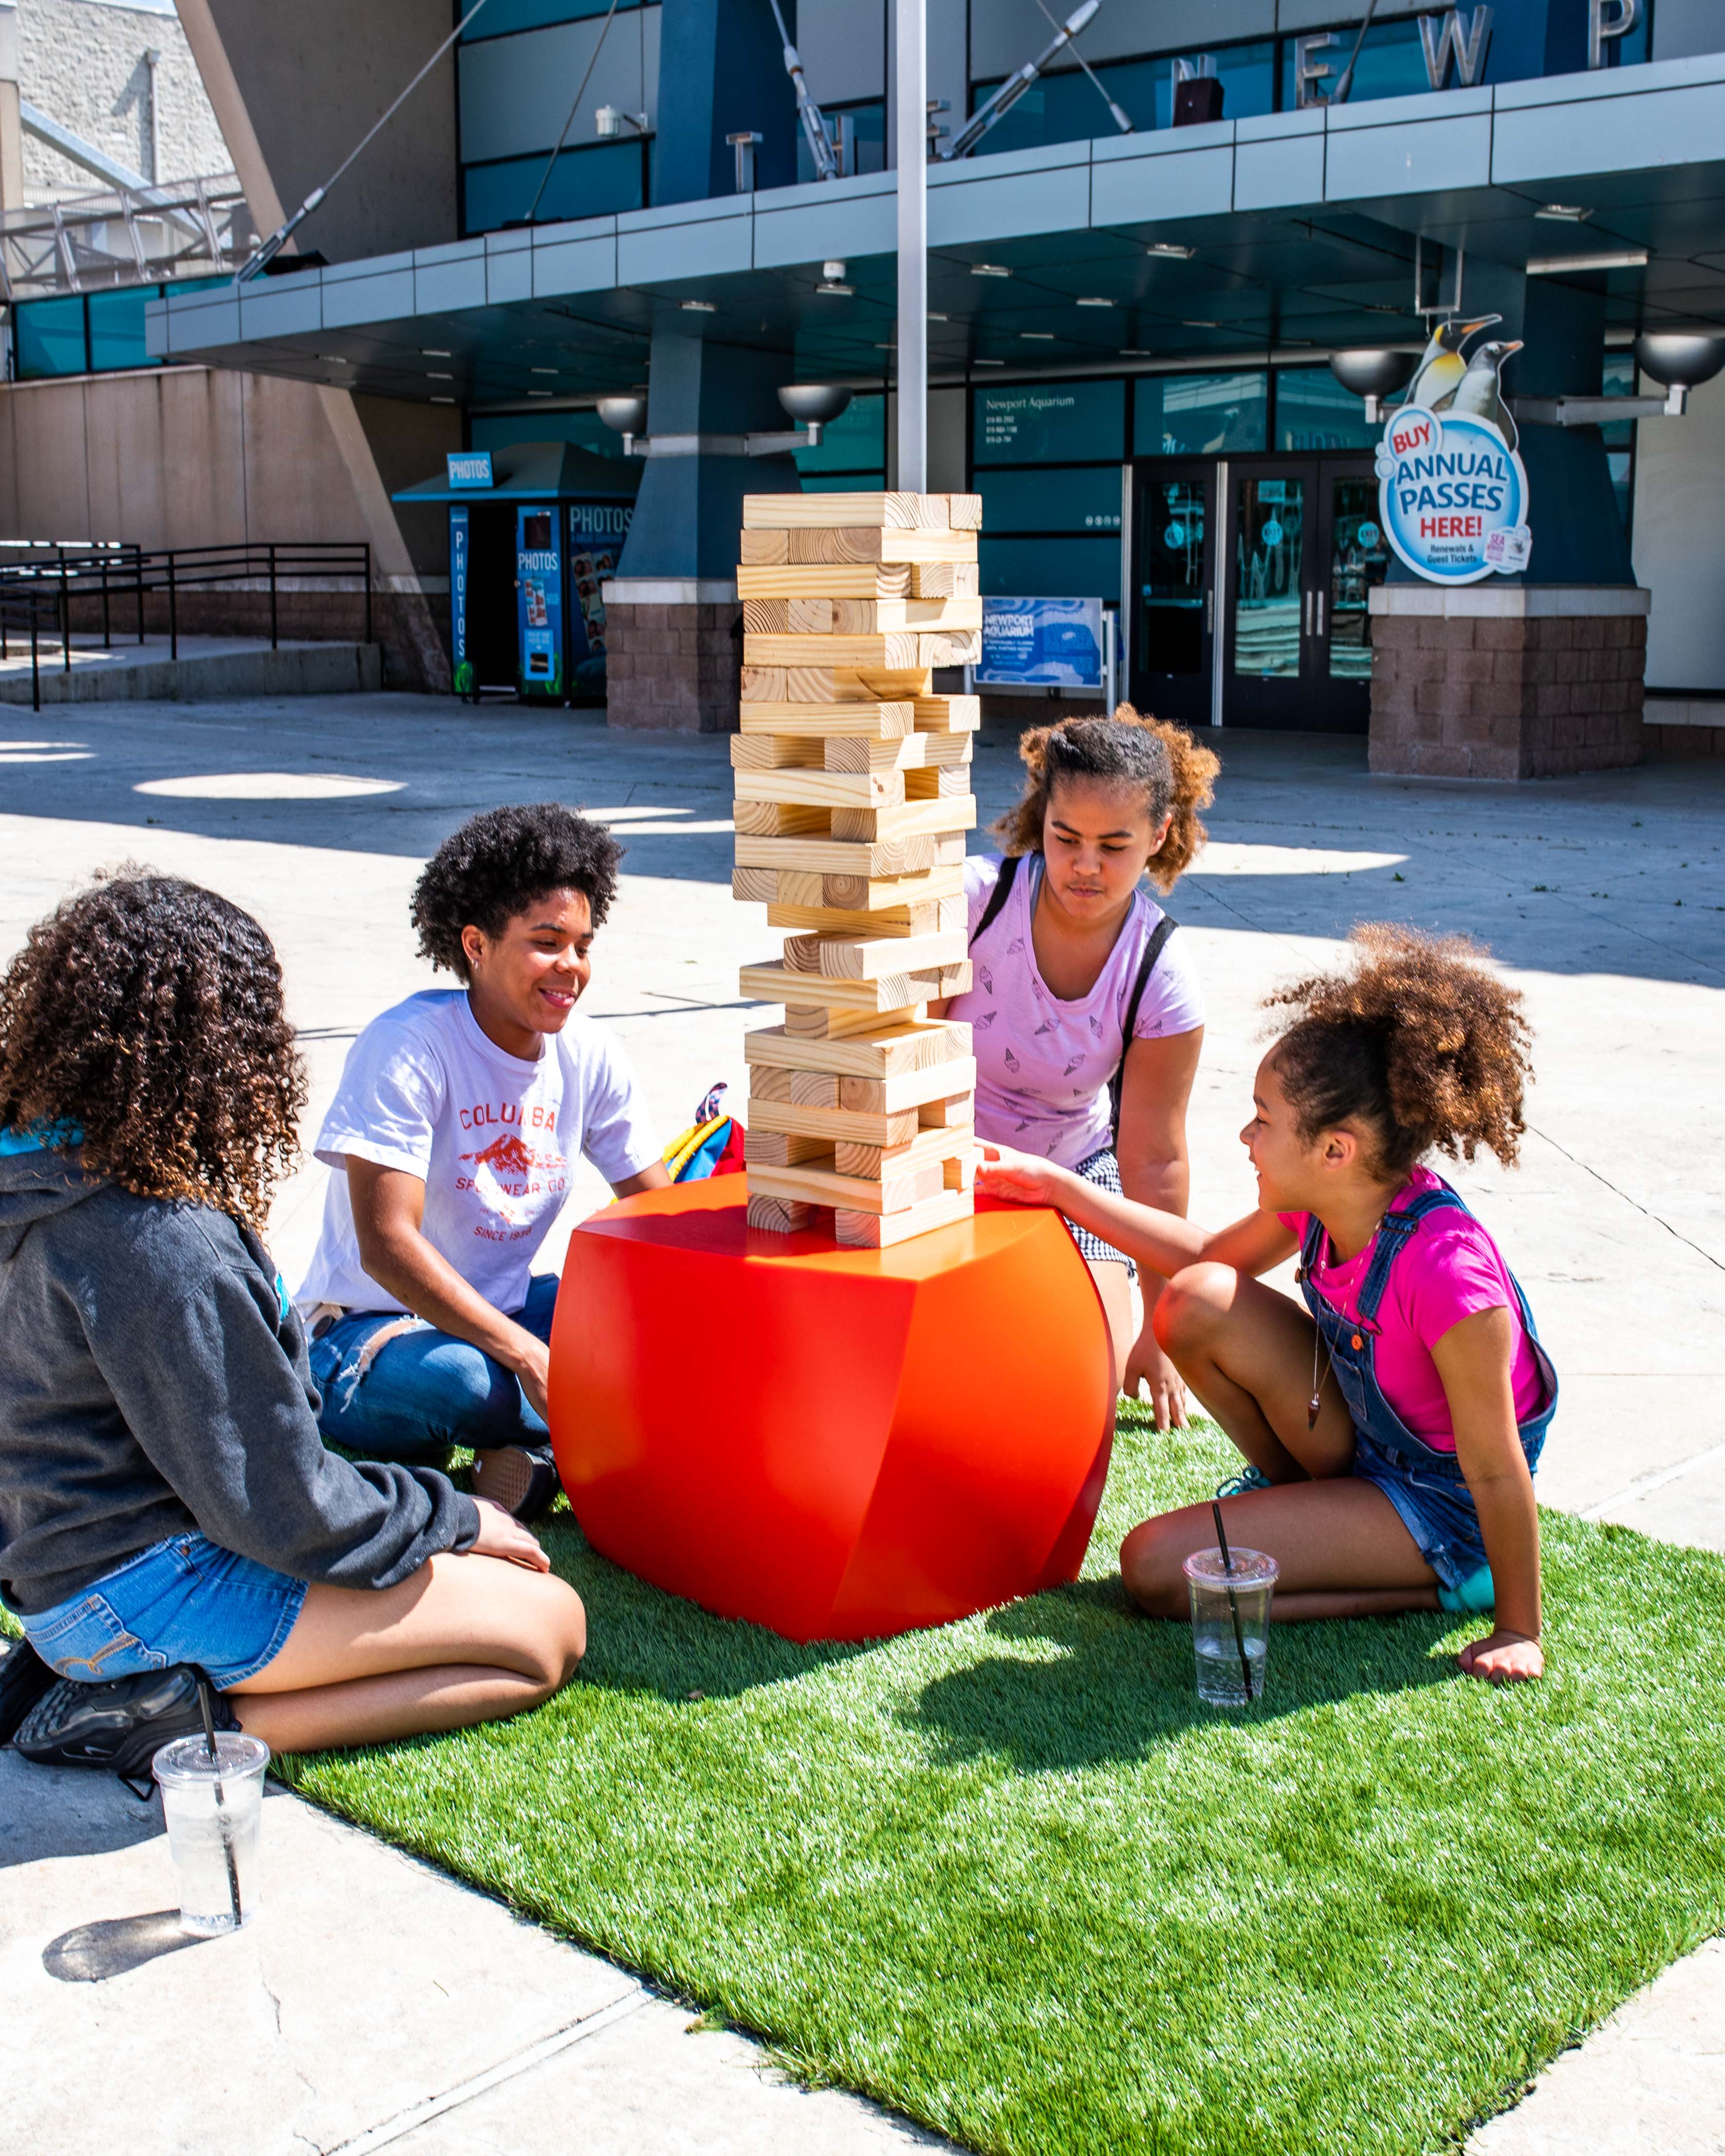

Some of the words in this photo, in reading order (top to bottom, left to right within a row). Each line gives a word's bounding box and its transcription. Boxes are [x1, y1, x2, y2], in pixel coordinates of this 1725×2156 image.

[986, 398, 1026, 412] Newport
[1029, 396, 1074, 411] Aquarium
[1393, 422, 1431, 454] BUY
[449, 459, 490, 480] PHOTOS
[1396, 452, 1508, 486] ANNUAL
[1400, 482, 1504, 515] PASSES
[569, 506, 633, 533] PHOTOS
[1420, 516, 1482, 538] HERE!
[1431, 544, 1466, 553] Renewals
[1468, 544, 1474, 553] &
[517, 552, 558, 571] PHOTOS
[1427, 554, 1449, 564] Guest
[1451, 554, 1477, 564] Tickets
[455, 531, 466, 657] PHOTOS
[985, 614, 1034, 626] NEWPORT
[984, 625, 1034, 637] AQUARIUM
[455, 1177, 540, 1196] SPWEAR
[474, 1225, 507, 1241] SINCE
